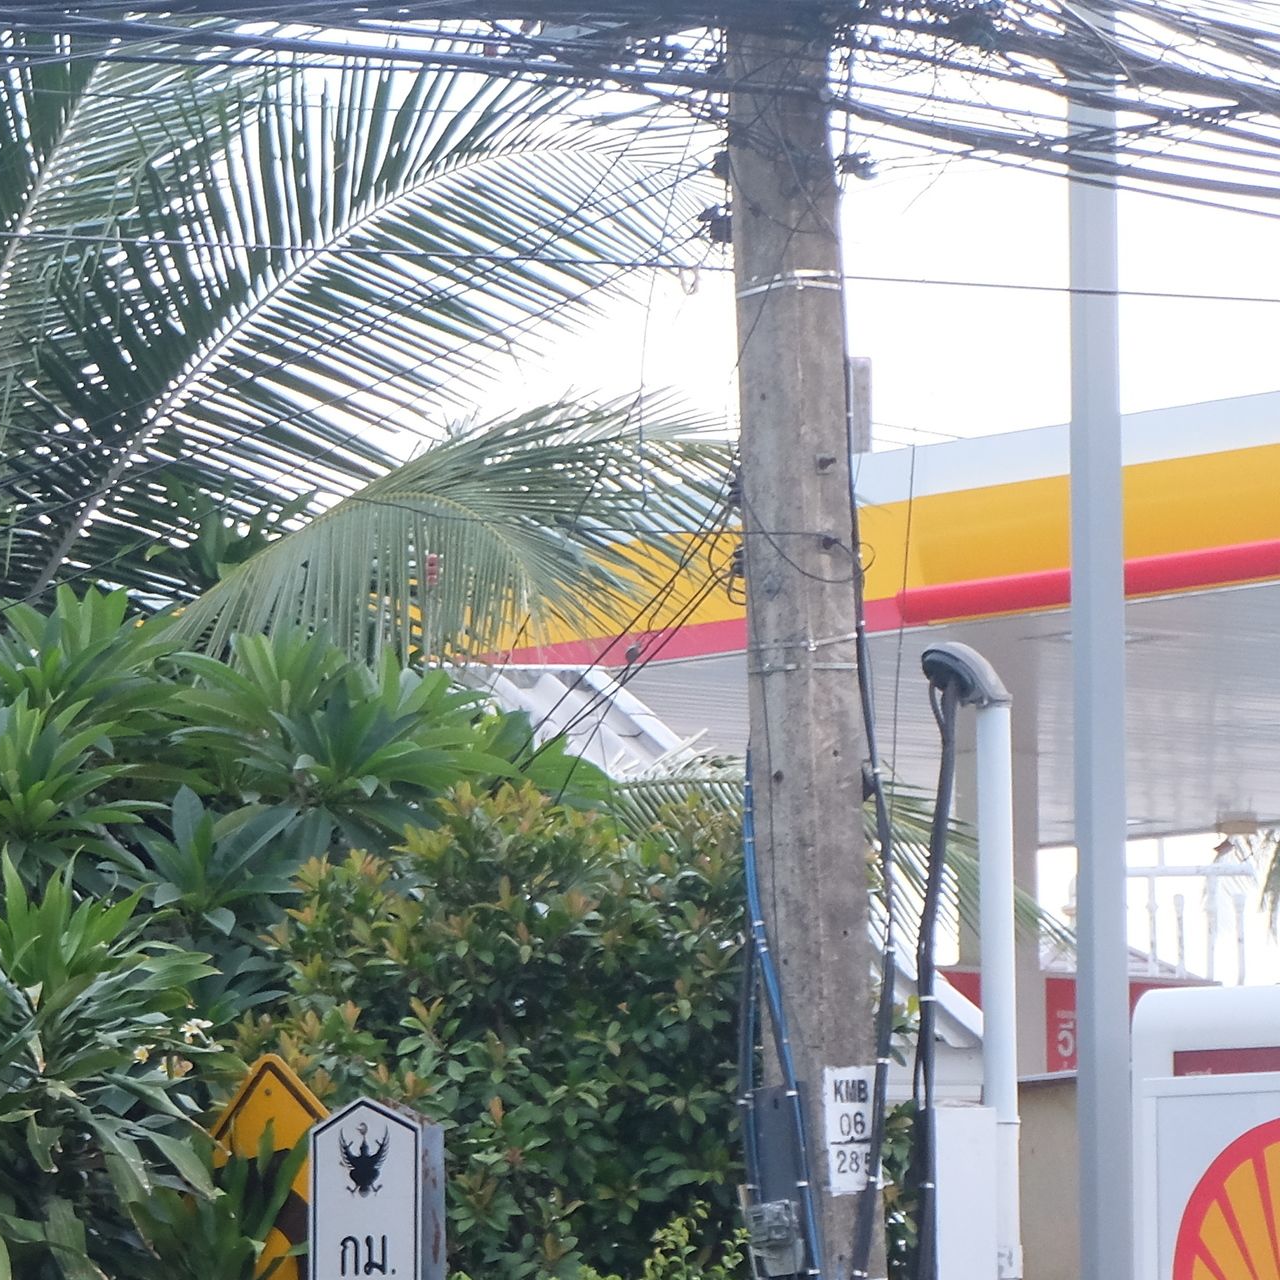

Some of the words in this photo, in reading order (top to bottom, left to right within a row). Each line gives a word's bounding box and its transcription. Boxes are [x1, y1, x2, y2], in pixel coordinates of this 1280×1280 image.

[834, 1079, 869, 1103] KMB
[839, 1112, 866, 1136] 06
[340, 1234, 397, 1277] กม.
